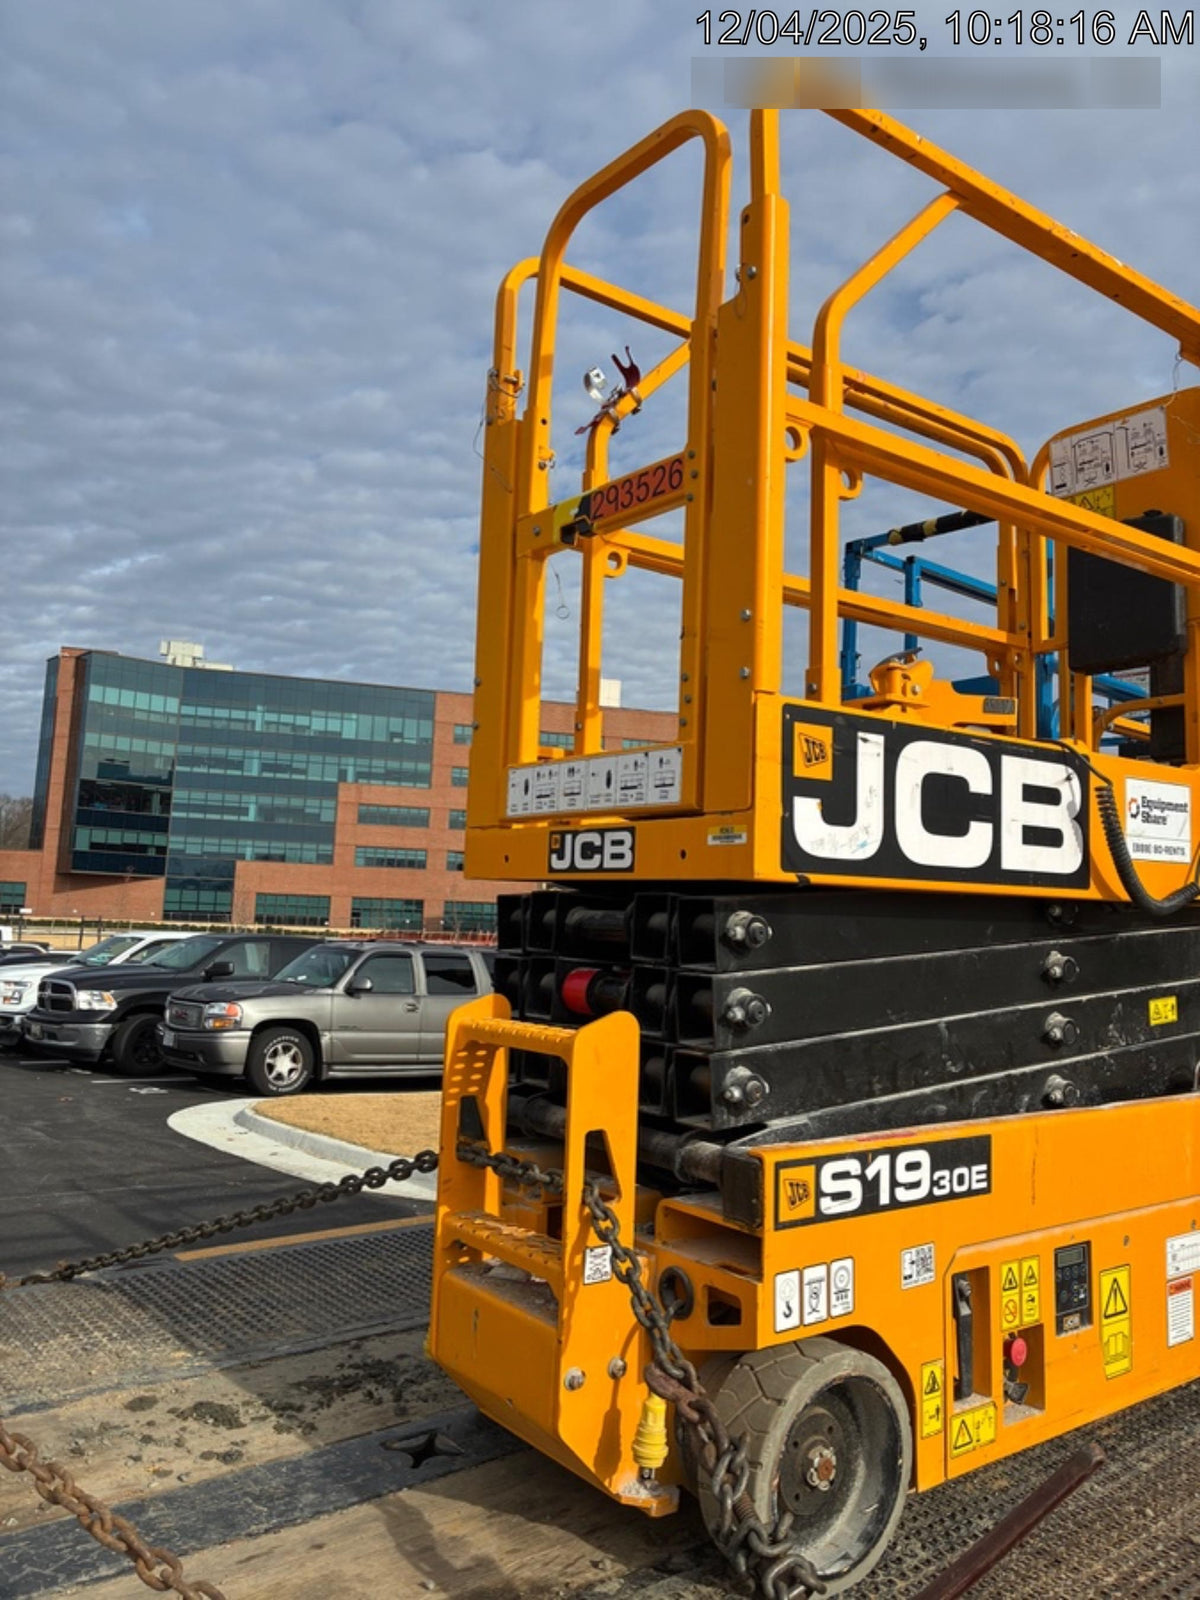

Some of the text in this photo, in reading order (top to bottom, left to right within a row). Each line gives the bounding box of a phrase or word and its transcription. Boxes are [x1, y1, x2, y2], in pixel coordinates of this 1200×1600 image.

[590, 458, 683, 521] 293526
[804, 737, 827, 763] JCB
[793, 732, 1082, 874] JCB
[1141, 796, 1188, 813] Equipment
[1141, 811, 1167, 825] Share
[551, 831, 633, 870] JCB
[788, 1181, 811, 1206] JCB
